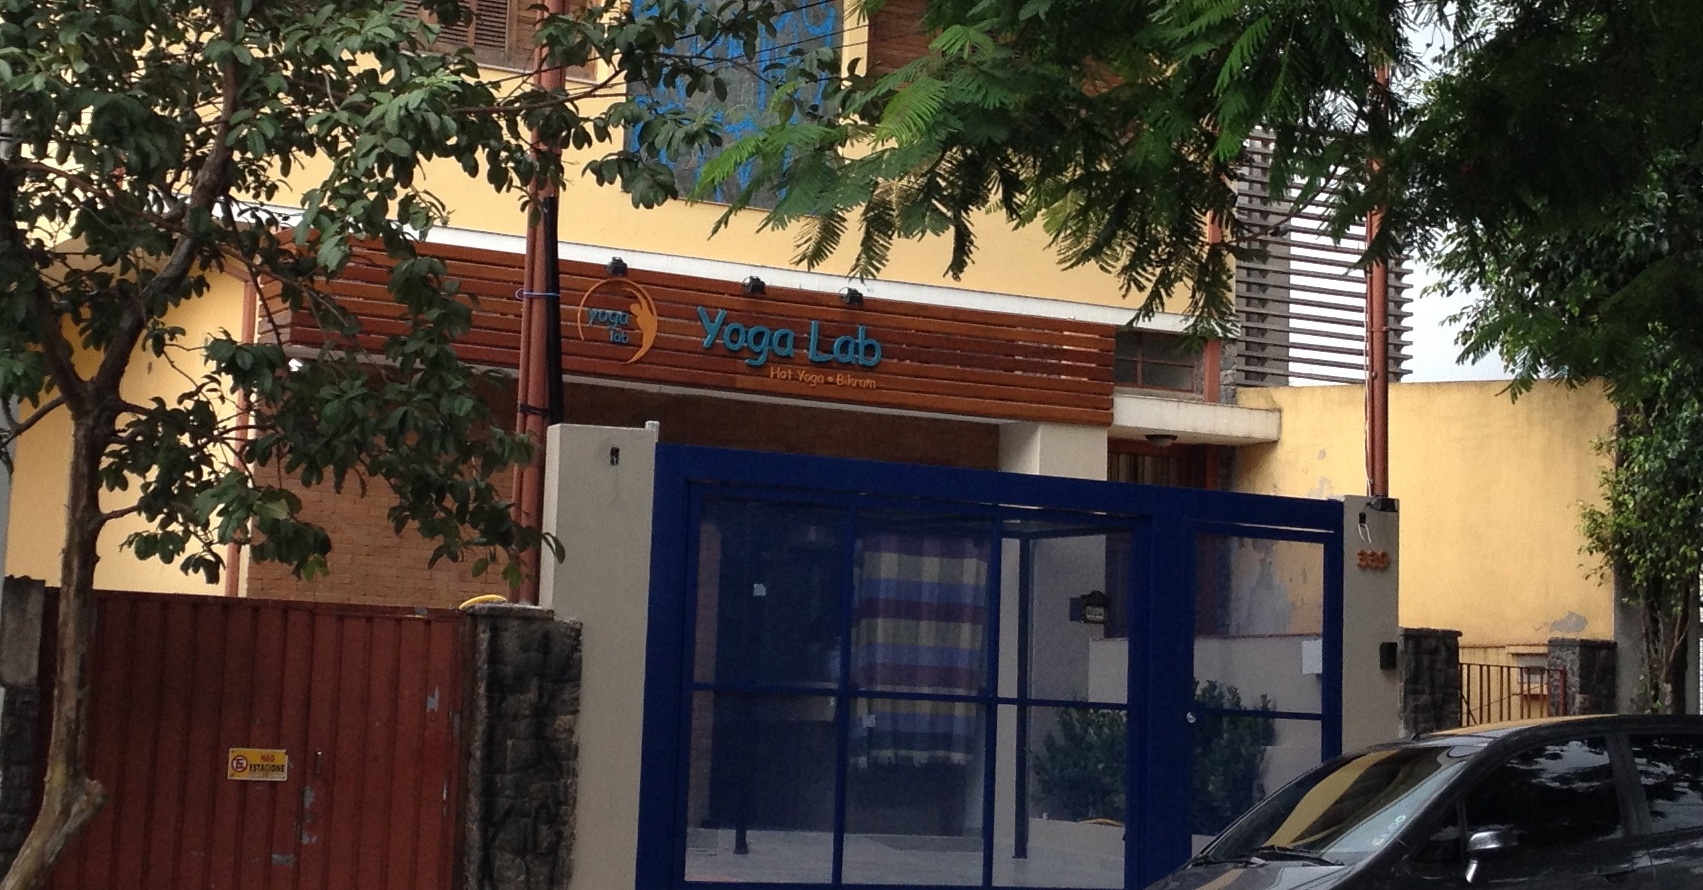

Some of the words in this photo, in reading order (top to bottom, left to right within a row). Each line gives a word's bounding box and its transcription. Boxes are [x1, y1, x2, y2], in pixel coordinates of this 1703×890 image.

[587, 307, 629, 329] yoga
[610, 330, 629, 344] lab
[697, 306, 795, 366] Yoga
[808, 320, 882, 367] Lab
[769, 366, 792, 380] Hot
[797, 369, 825, 387] Yoga
[836, 373, 877, 389] Bikram
